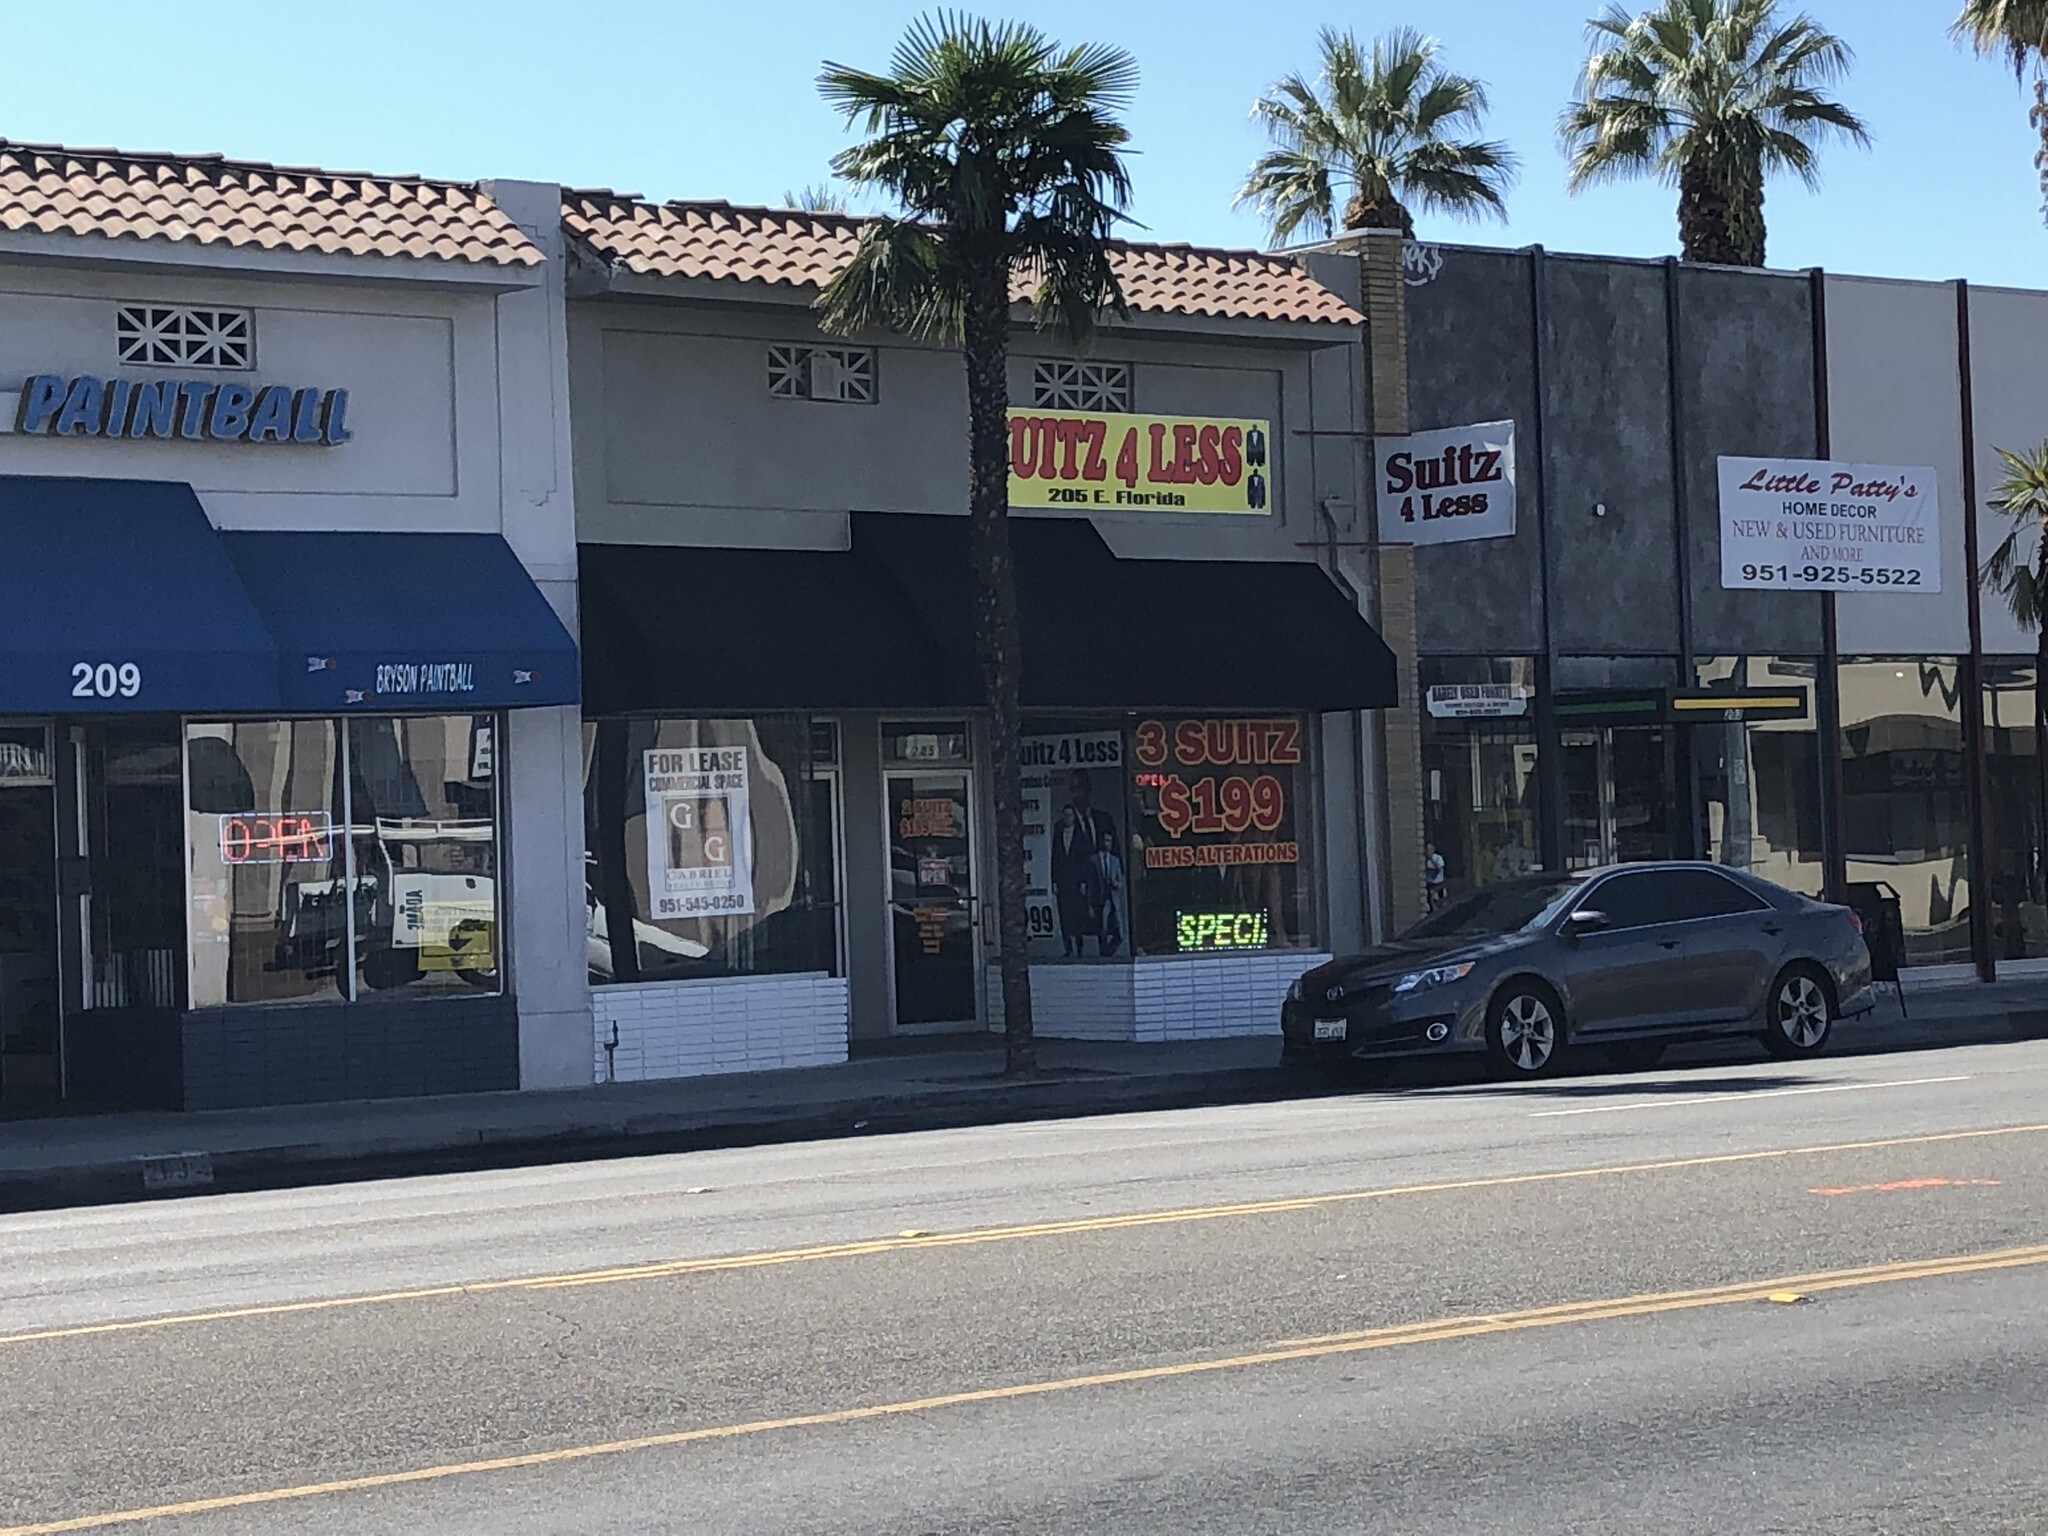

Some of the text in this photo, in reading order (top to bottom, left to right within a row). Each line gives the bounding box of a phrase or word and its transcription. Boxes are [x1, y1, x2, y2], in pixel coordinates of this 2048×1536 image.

[17, 375, 354, 445] PAINTBALL
[1005, 416, 1242, 488] UITZ 4 LESS
[1386, 444, 1502, 494] Suitz
[1048, 487, 1088, 506] 205
[1116, 489, 1186, 507] Florida
[1739, 468, 1918, 502] Little Patty's
[1400, 491, 1489, 522] 4 Less
[1782, 501, 1877, 519] HOME DECOR
[1732, 520, 1925, 544] NEW & USED FURNITURE
[1801, 546, 1863, 563] AND MORE
[1741, 563, 1922, 586] 951-925-5522
[71, 663, 142, 698] 209
[376, 663, 475, 694] BRYSON PAINTBALL
[1020, 738, 1119, 766] uitz 4 Less
[1136, 719, 1300, 766] 3 SUITZ
[648, 751, 743, 774] FOR LEASE
[714, 773, 744, 790] SPACE
[670, 802, 692, 829] G
[1158, 774, 1283, 838] $199
[704, 836, 726, 862] G
[1146, 842, 1299, 868] MENS ALTERATIONS
[667, 868, 733, 881] GABRIEL
[921, 869, 946, 883] OPEN
[659, 893, 744, 913] 951-545-0250
